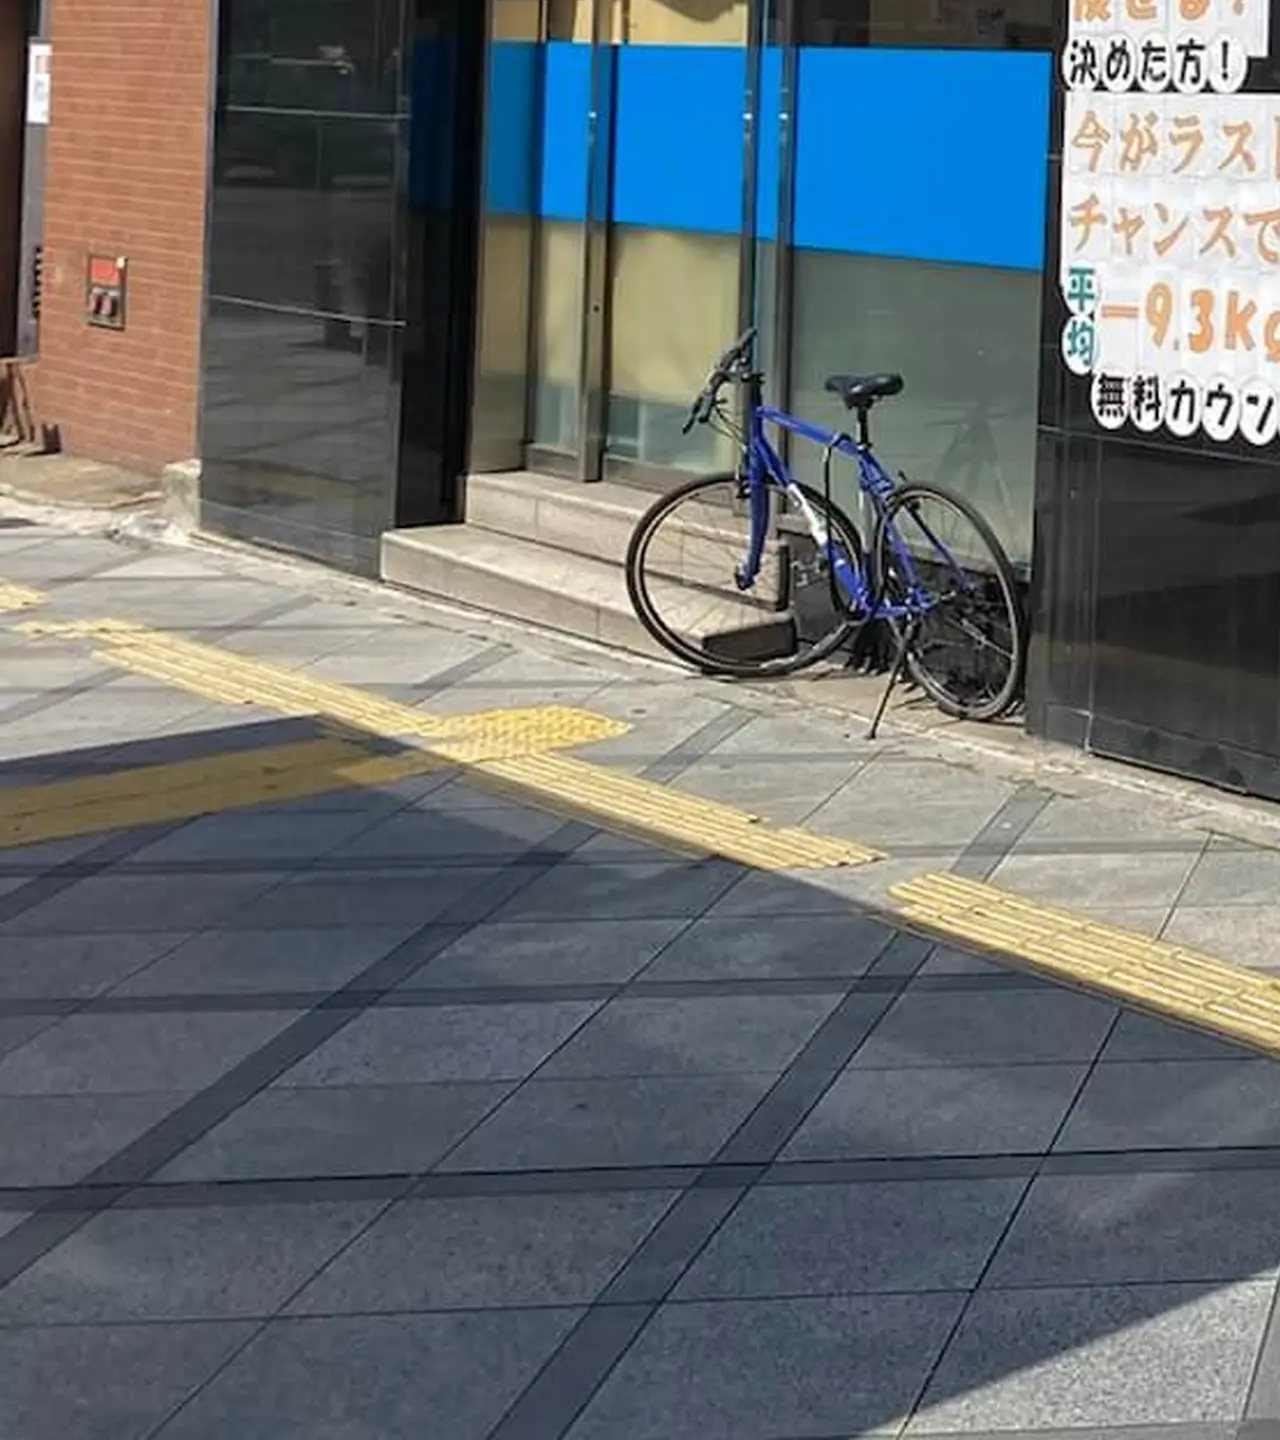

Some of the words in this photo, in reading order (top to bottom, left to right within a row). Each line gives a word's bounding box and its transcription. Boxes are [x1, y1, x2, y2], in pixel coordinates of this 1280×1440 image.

[1068, 37, 1238, 86] 決めた方！
[1067, 267, 1096, 368] 平均
